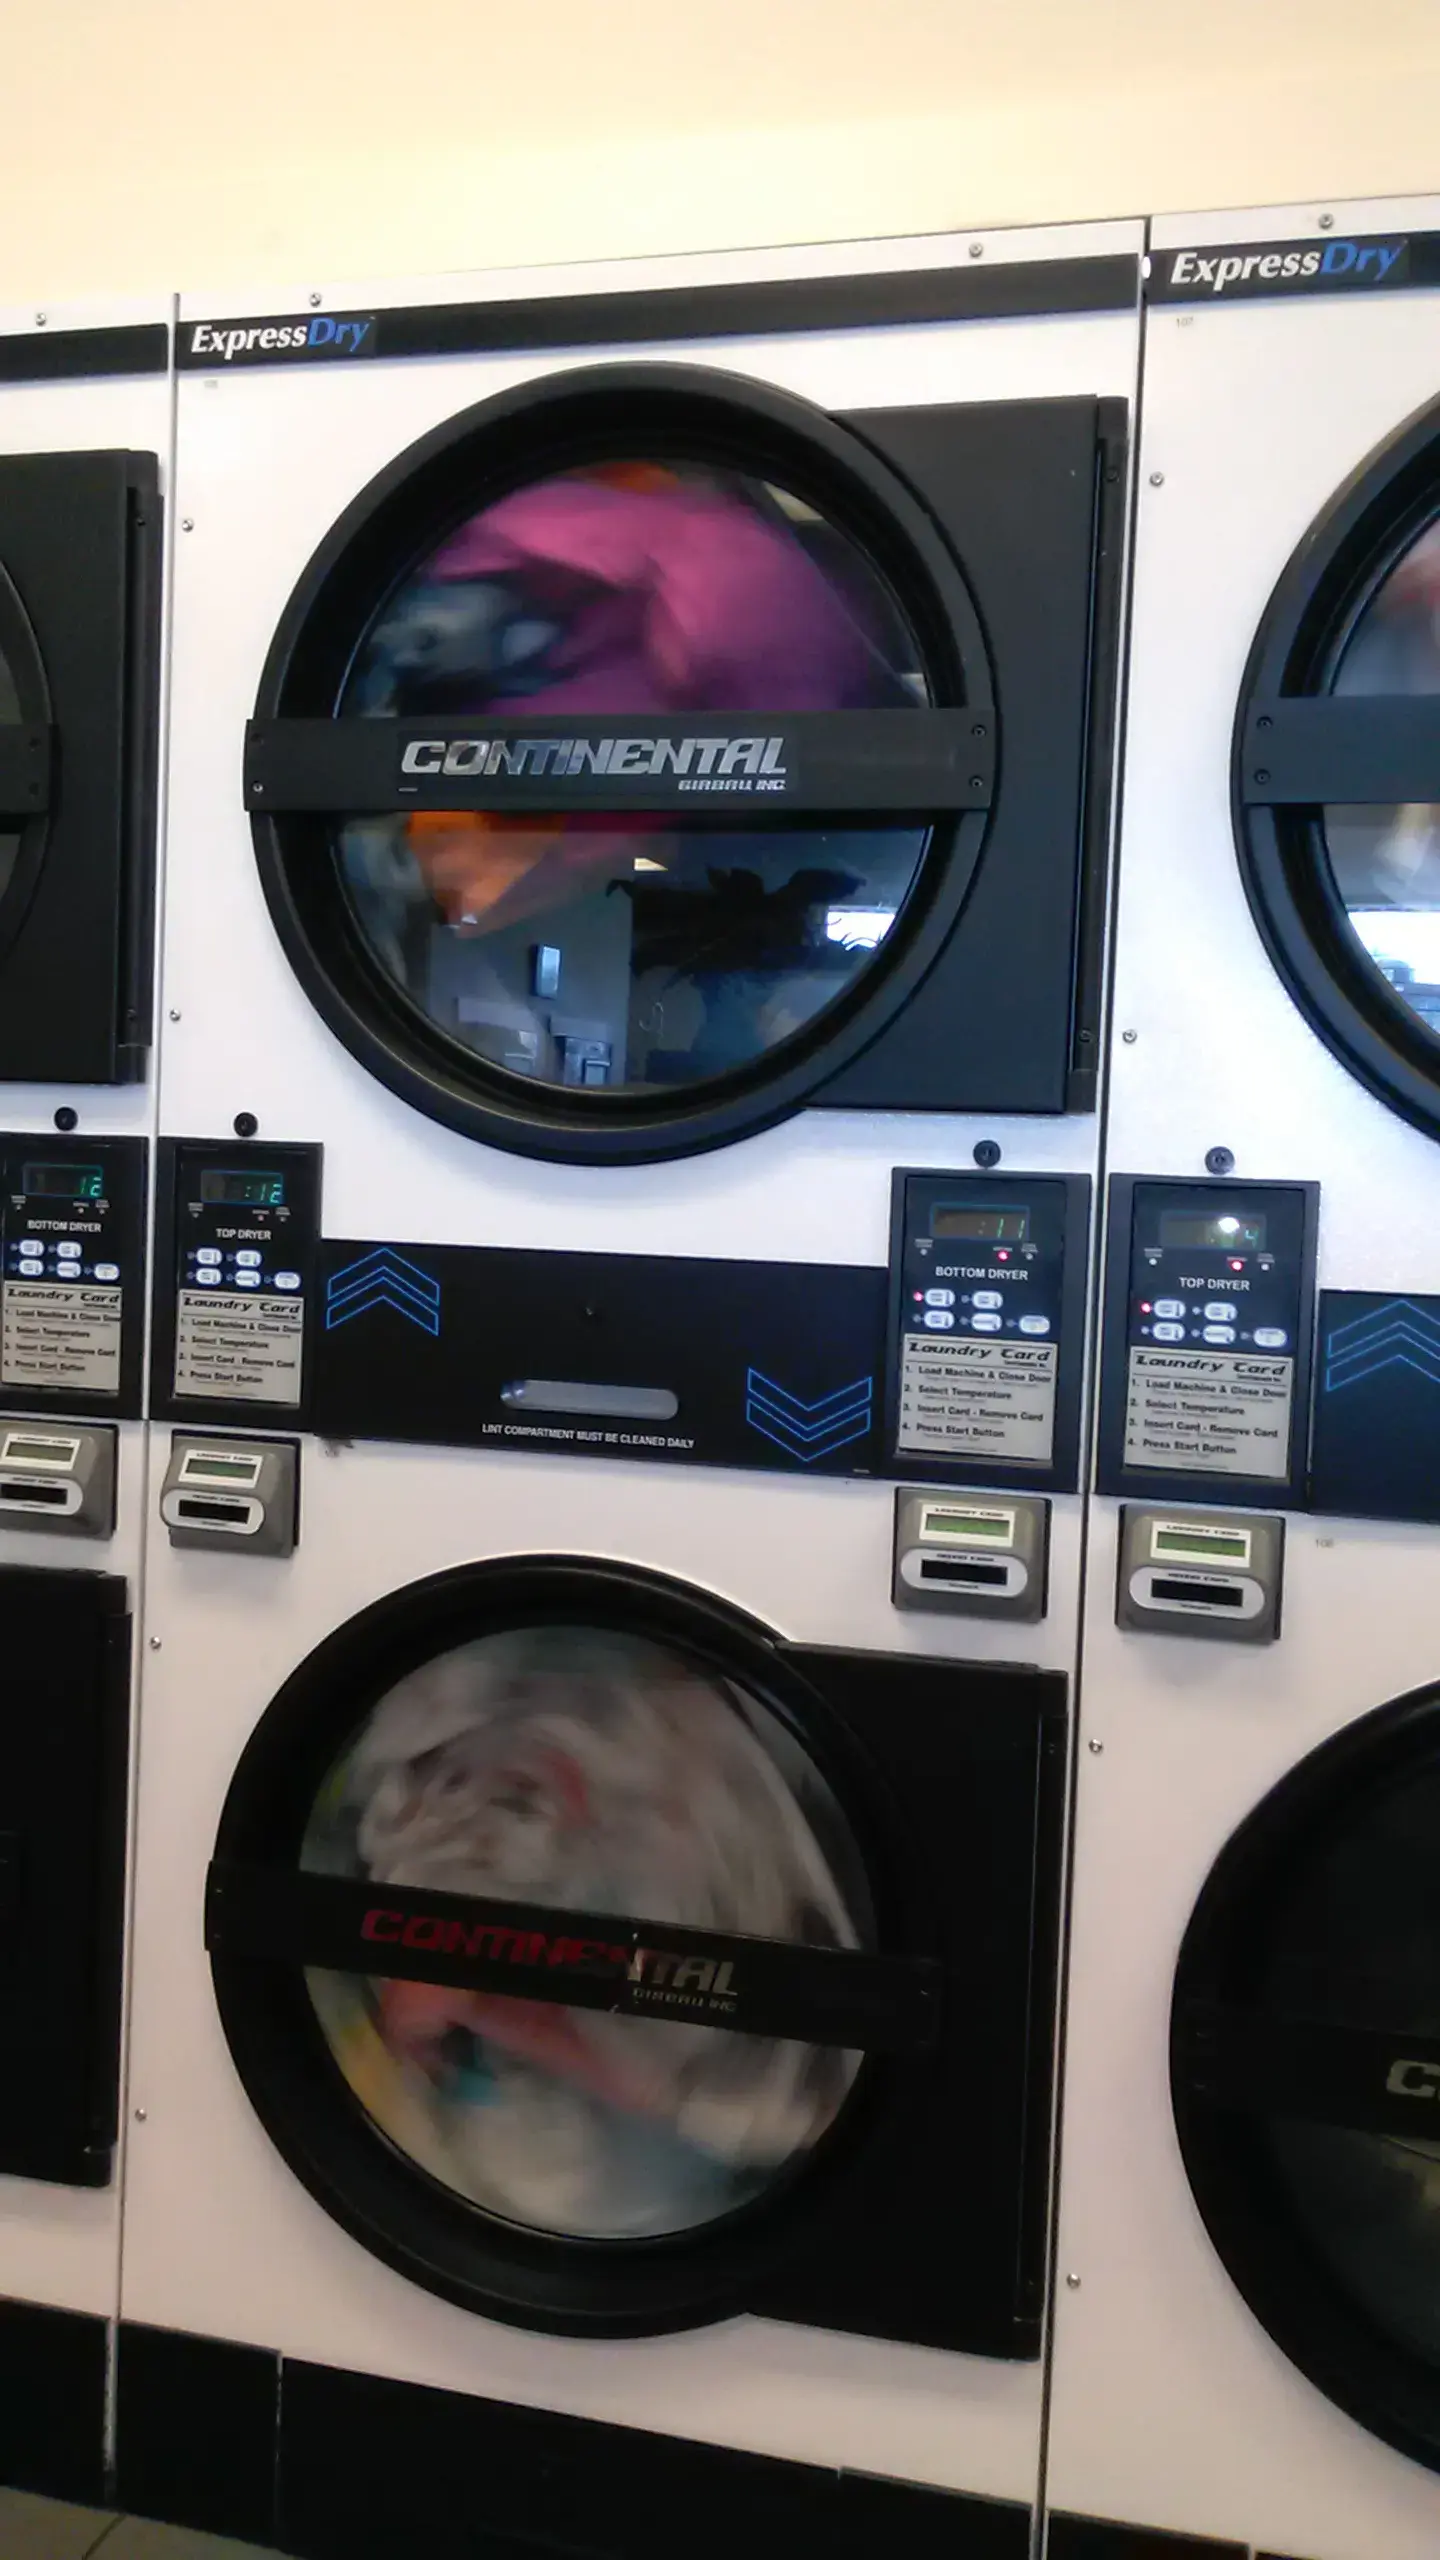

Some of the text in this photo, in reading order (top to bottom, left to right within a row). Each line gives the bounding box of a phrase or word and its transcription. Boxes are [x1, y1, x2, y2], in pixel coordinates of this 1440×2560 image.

[1170, 241, 1404, 291] ExpressDry
[191, 317, 370, 360] ExpressDry
[401, 738, 786, 775] CONTINENTAL
[27, 1220, 101, 1232] BOTTOM DRYER
[216, 1228, 271, 1240] TOP DRYER
[935, 1266, 1028, 1280] BOTTOM DRYER
[1179, 1277, 1250, 1291] TOP DRYER
[7, 1288, 119, 1303] Laundry Card
[184, 1297, 300, 1313] Laundry Card
[908, 1342, 1050, 1361] Laundry Card
[918, 1366, 942, 1374] Load
[1135, 1354, 1286, 1375] Laundry Card
[1146, 1379, 1170, 1389] Load
[482, 1423, 695, 1448] LINT COMPARTMENT MUST BE CLEANED DAILY
